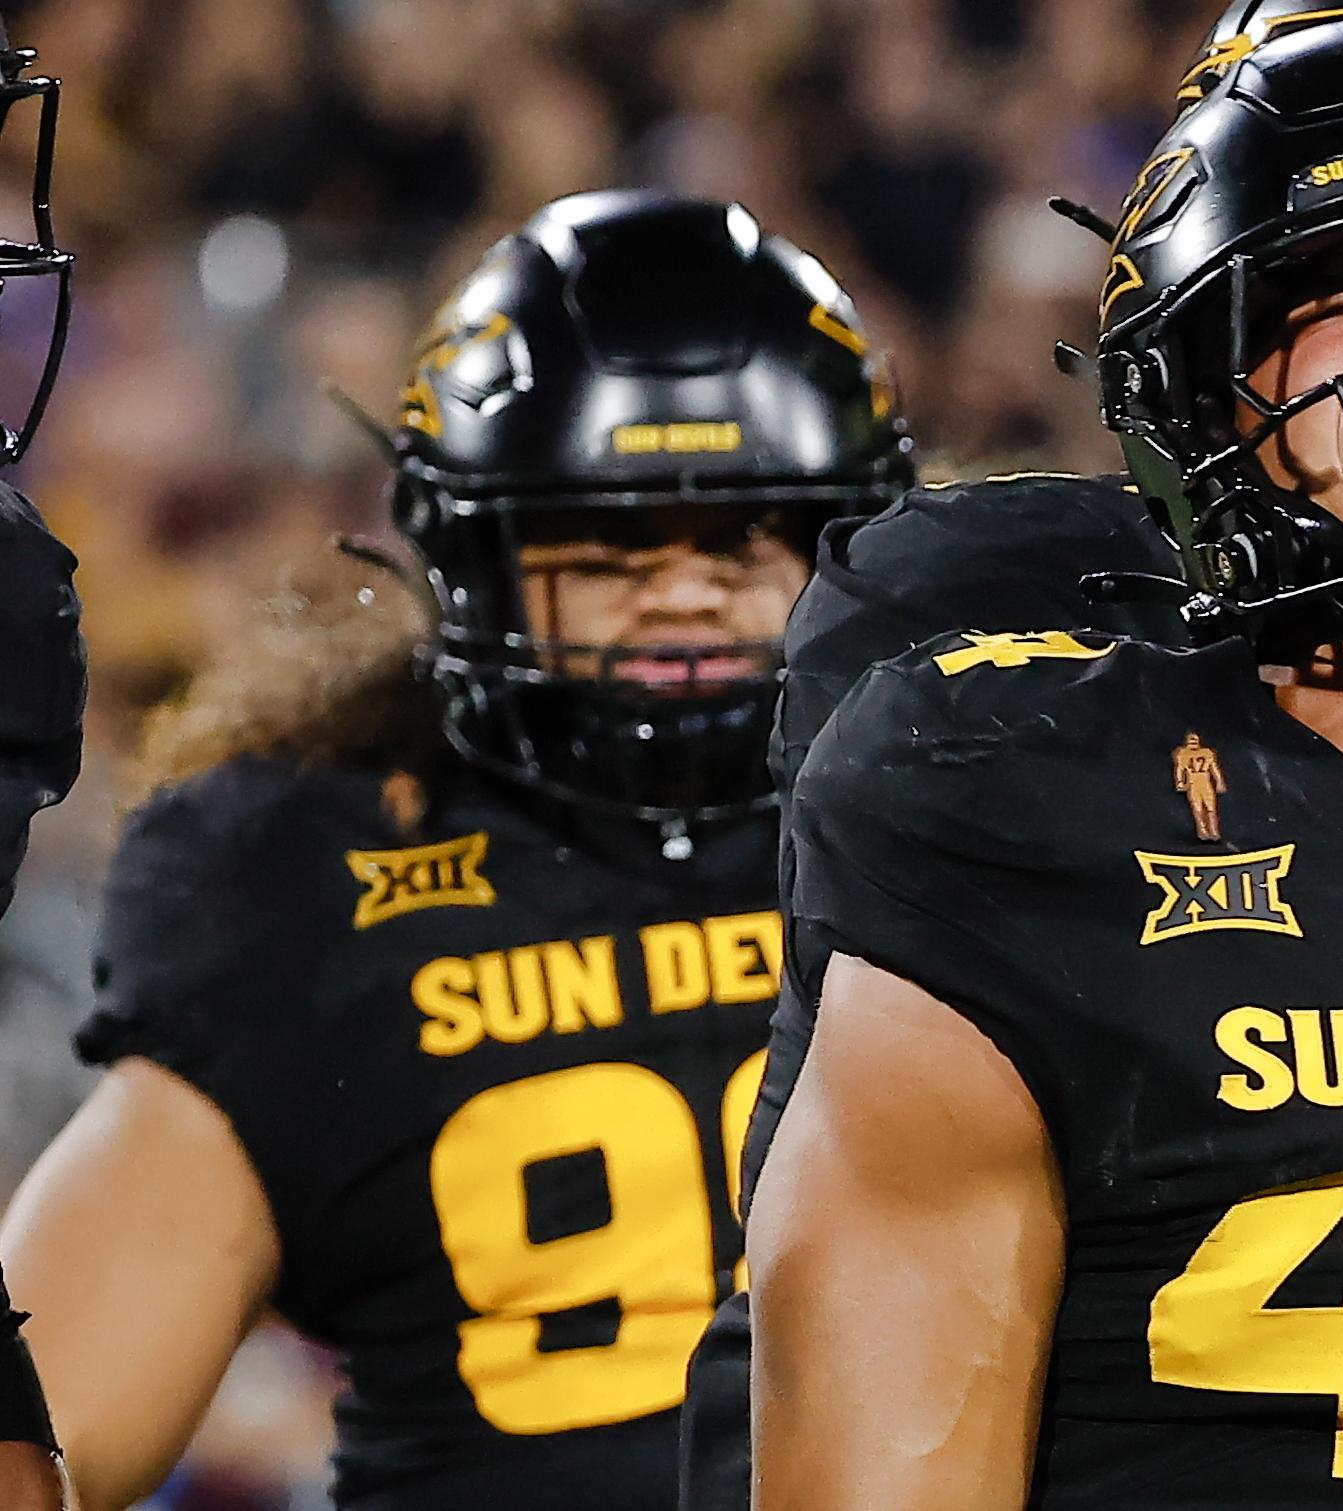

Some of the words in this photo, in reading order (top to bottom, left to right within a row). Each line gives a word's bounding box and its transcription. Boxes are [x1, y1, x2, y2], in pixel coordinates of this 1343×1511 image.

[1150, 855, 1288, 933] XII
[410, 934, 624, 1057] SUN
[430, 1047, 769, 1436] 9
